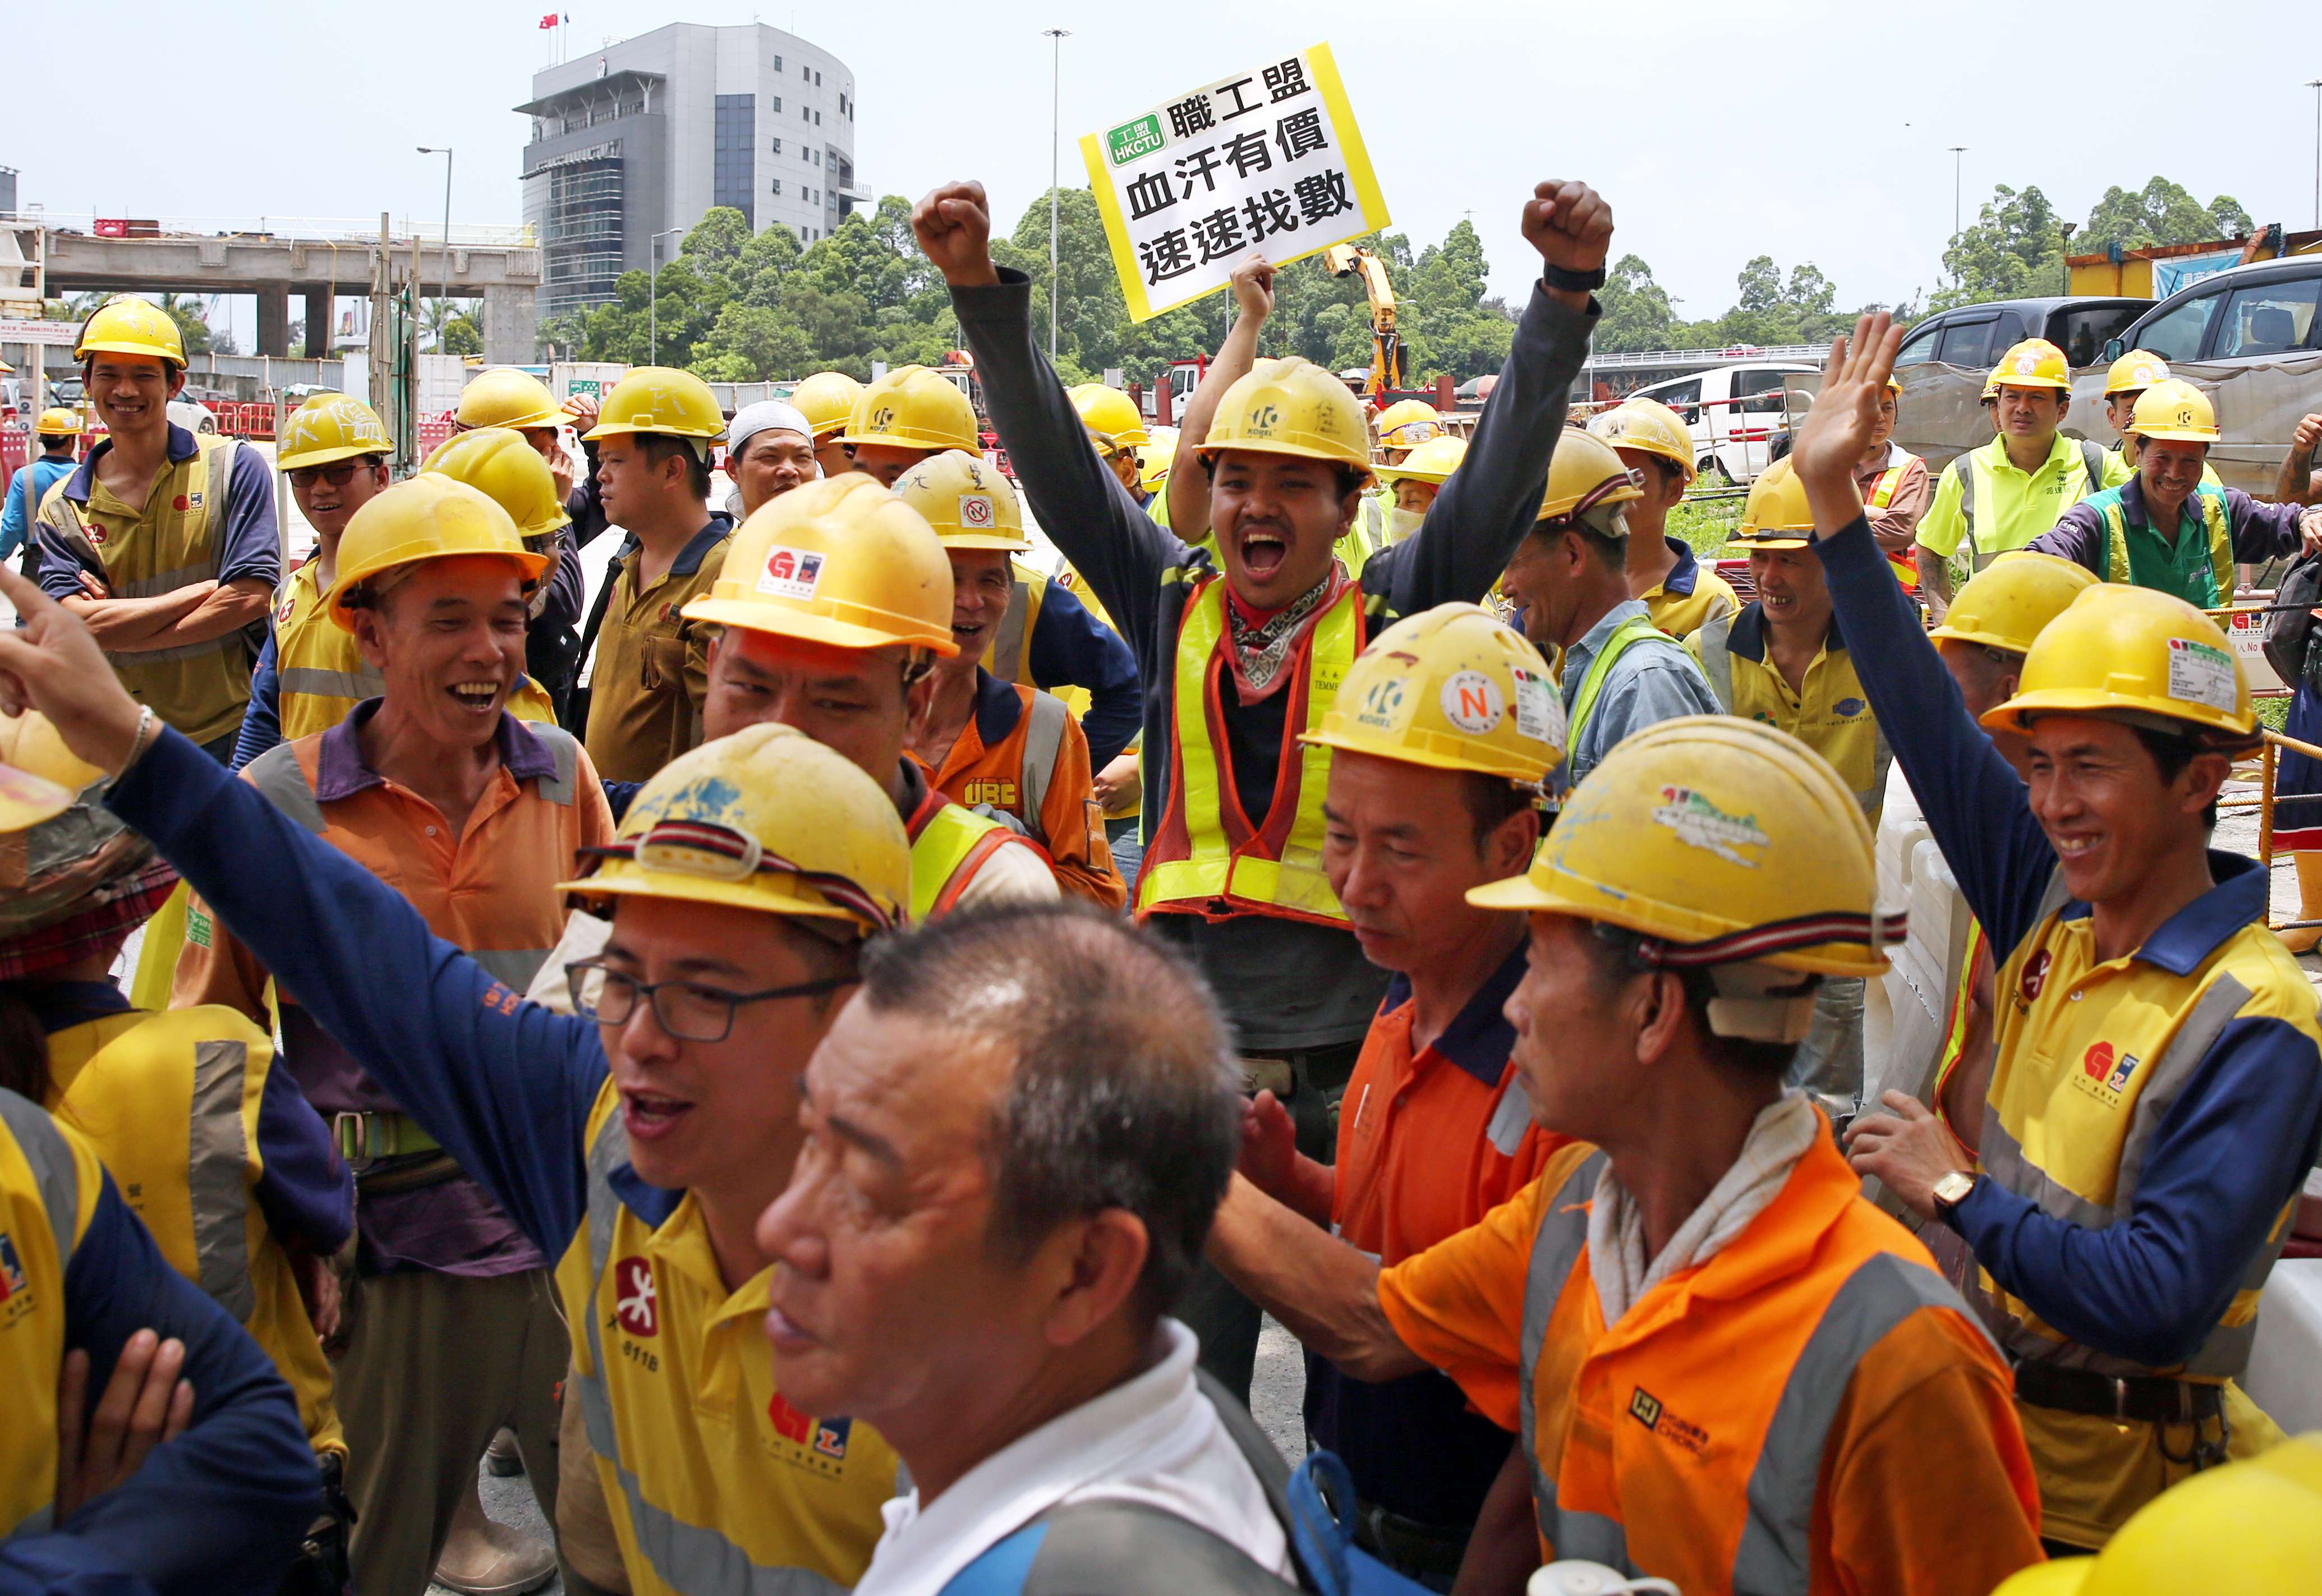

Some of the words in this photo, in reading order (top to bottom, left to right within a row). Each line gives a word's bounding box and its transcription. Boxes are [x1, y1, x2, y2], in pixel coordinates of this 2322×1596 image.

[1167, 57, 1311, 138] 職工盟
[1115, 132, 1161, 161] HKCTU
[1118, 121, 1151, 145] 工盟
[1126, 107, 1328, 220] 血汗有價
[1138, 169, 1353, 286] 速速找數
[1460, 687, 1488, 718] N
[964, 778, 1016, 804] UBC
